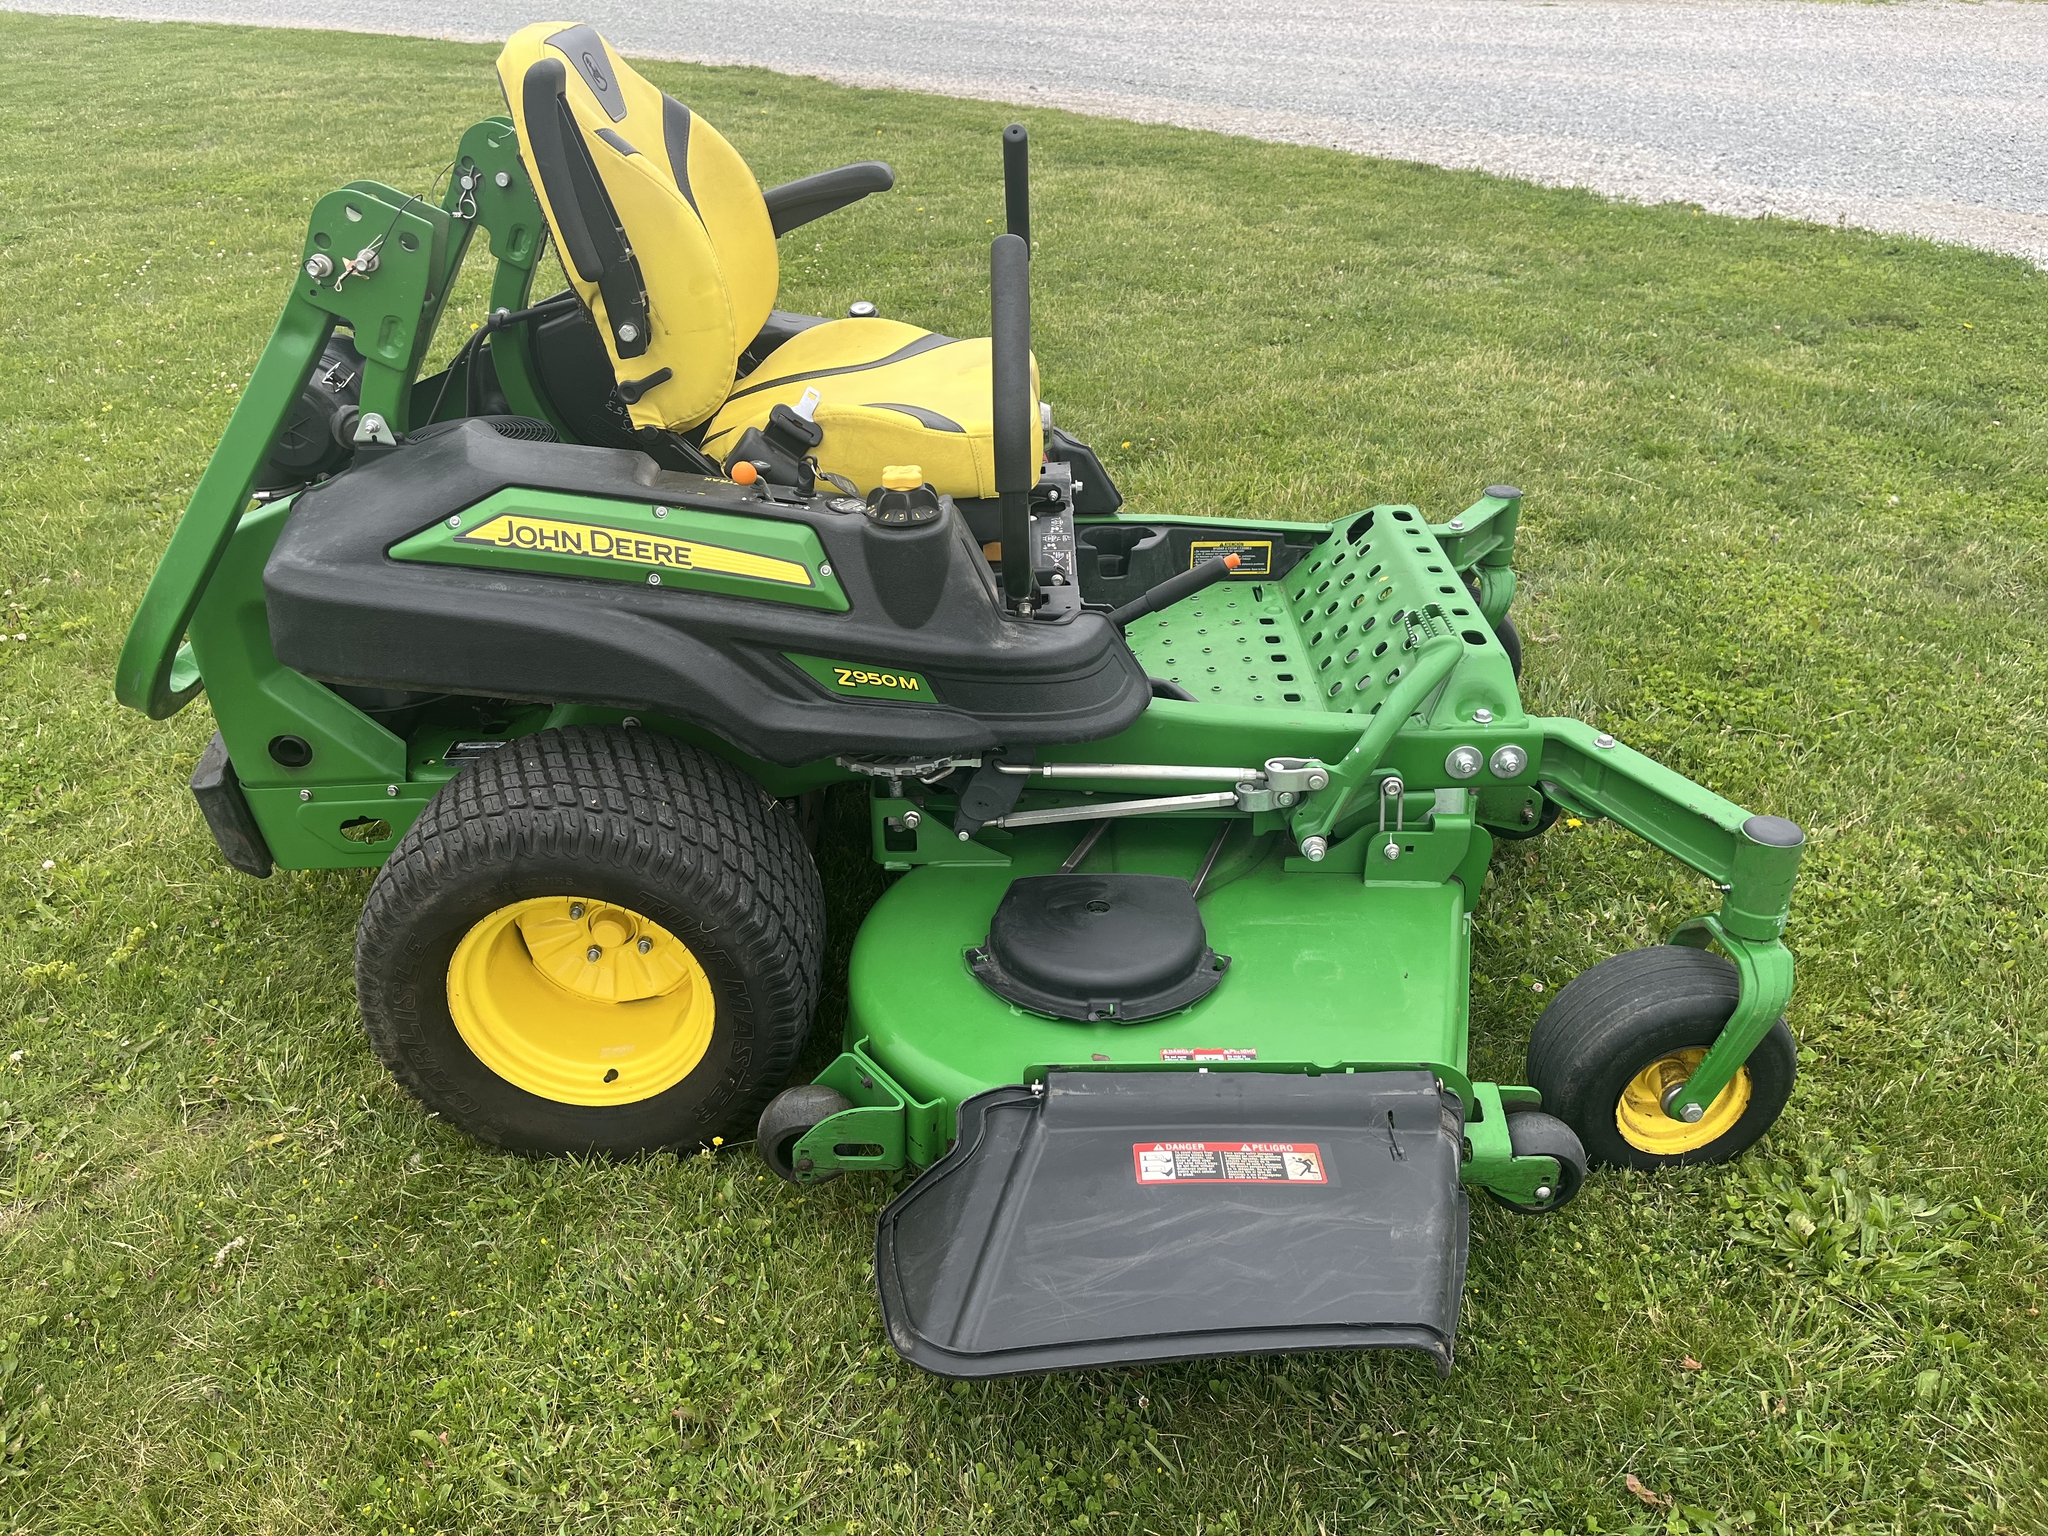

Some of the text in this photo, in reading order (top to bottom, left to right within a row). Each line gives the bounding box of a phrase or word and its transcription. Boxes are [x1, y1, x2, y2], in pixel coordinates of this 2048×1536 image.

[498, 520, 693, 567] JOHN DEERE
[393, 932, 481, 1114] CARLISLE
[637, 890, 755, 1124] TURF MASTER
[1165, 1143, 1294, 1152] DANGER PELIGRO
